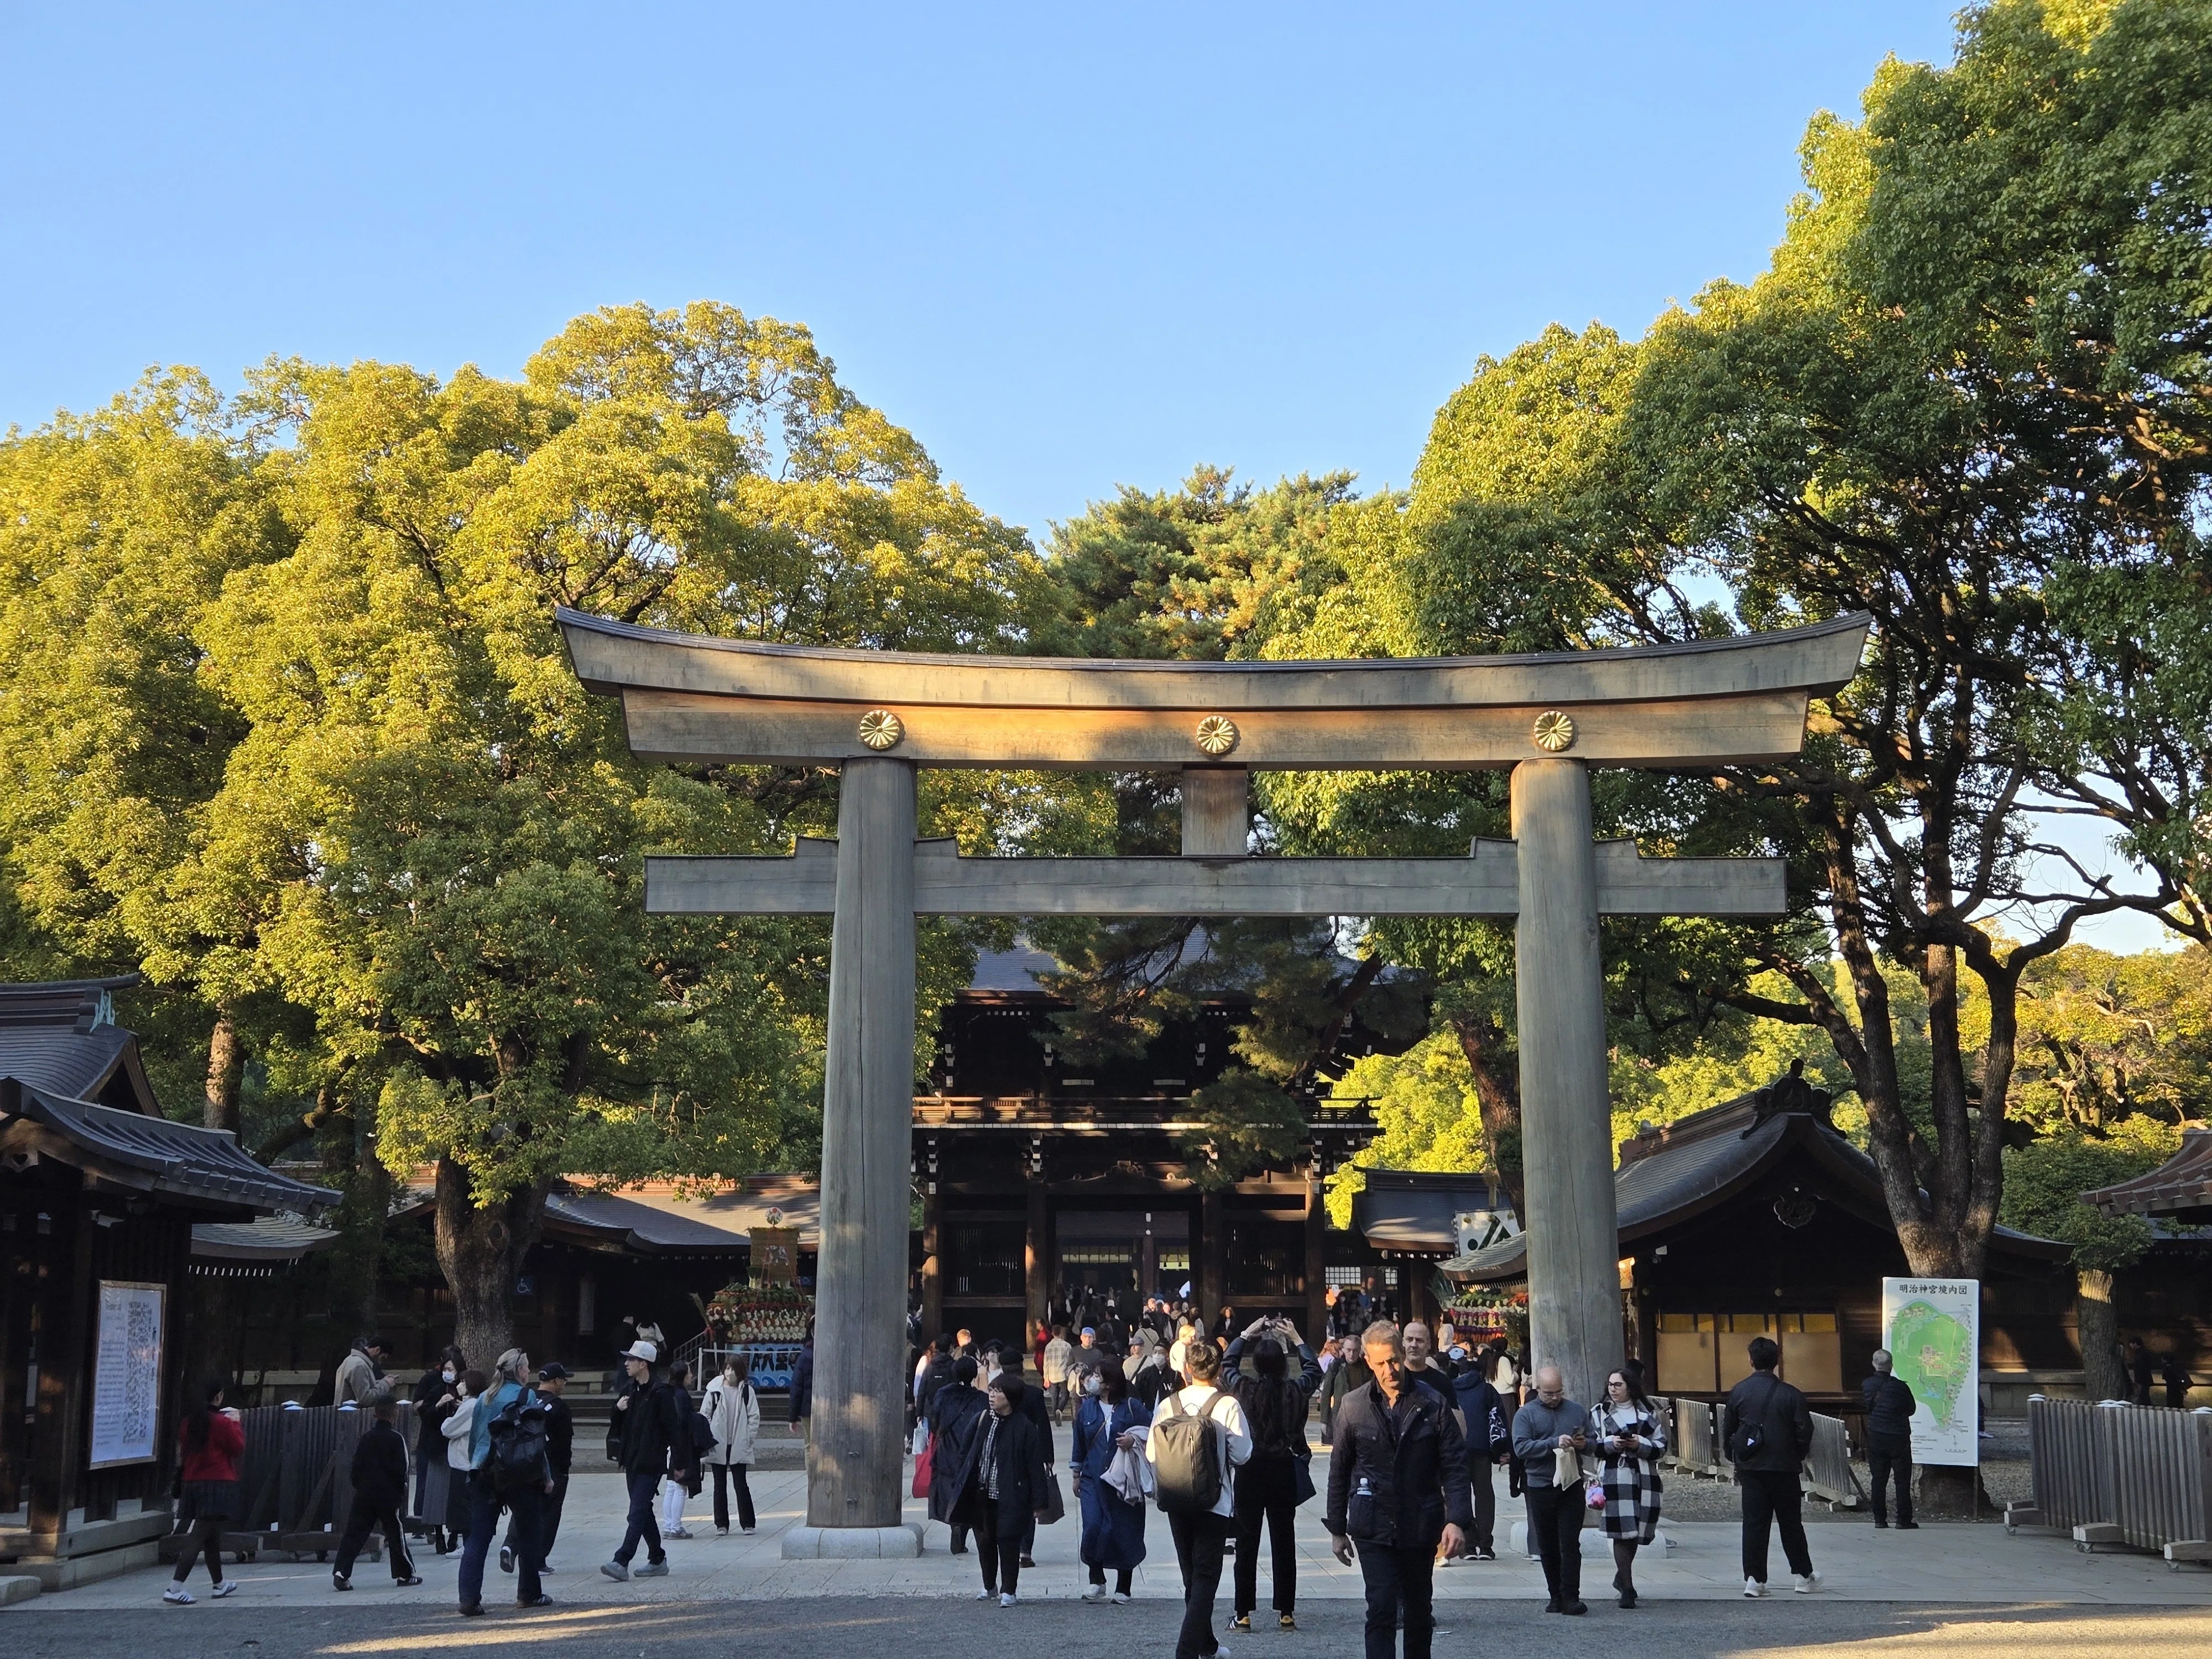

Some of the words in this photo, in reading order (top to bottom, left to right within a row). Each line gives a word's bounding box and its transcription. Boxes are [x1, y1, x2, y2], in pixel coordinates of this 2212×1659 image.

[1899, 1284, 1967, 1295] 明治神宮境内図
